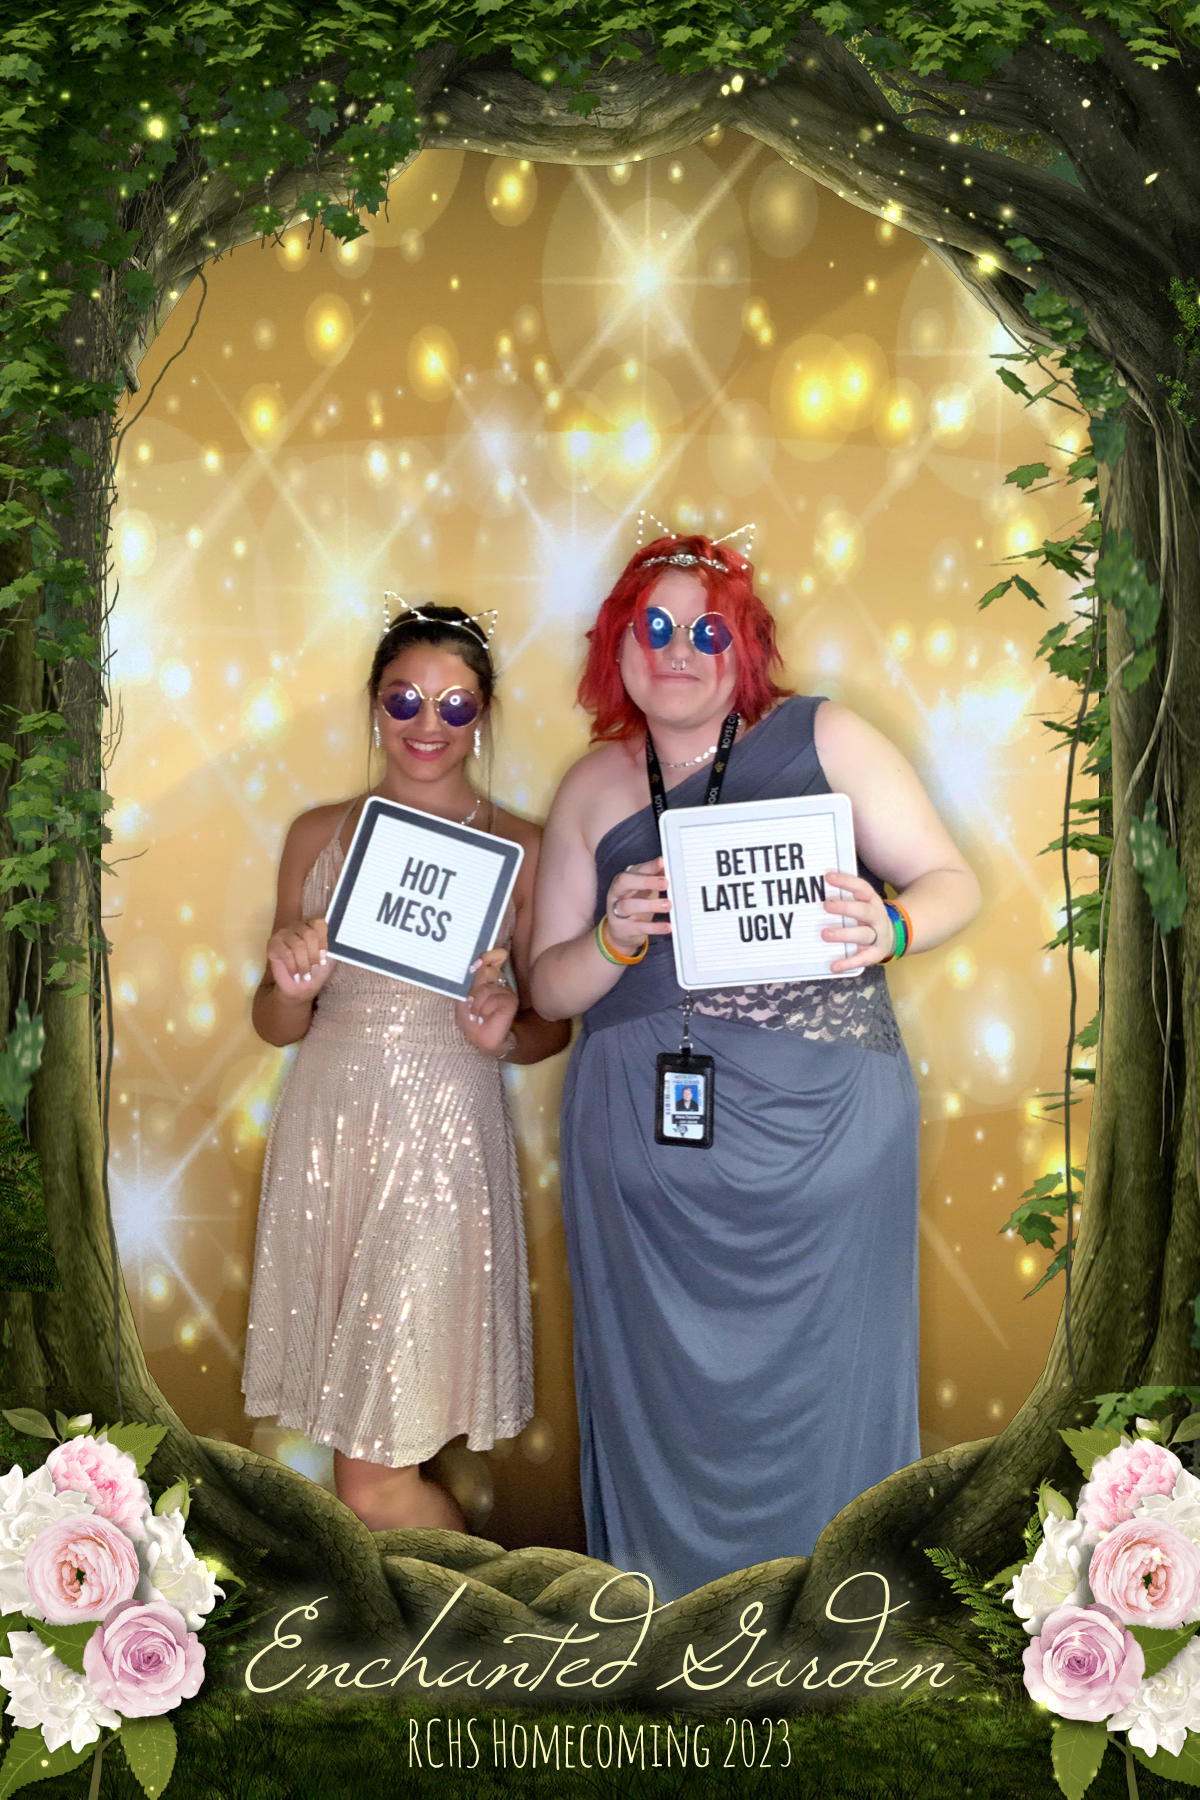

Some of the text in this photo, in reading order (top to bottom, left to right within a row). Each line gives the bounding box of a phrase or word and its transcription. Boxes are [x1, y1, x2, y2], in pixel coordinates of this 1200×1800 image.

[707, 786, 719, 806] OOL
[715, 842, 805, 877] BETTER
[399, 856, 457, 900] HOT
[701, 874, 827, 912] LATE THAN
[375, 891, 453, 943] MESS
[738, 911, 795, 943] UGLY
